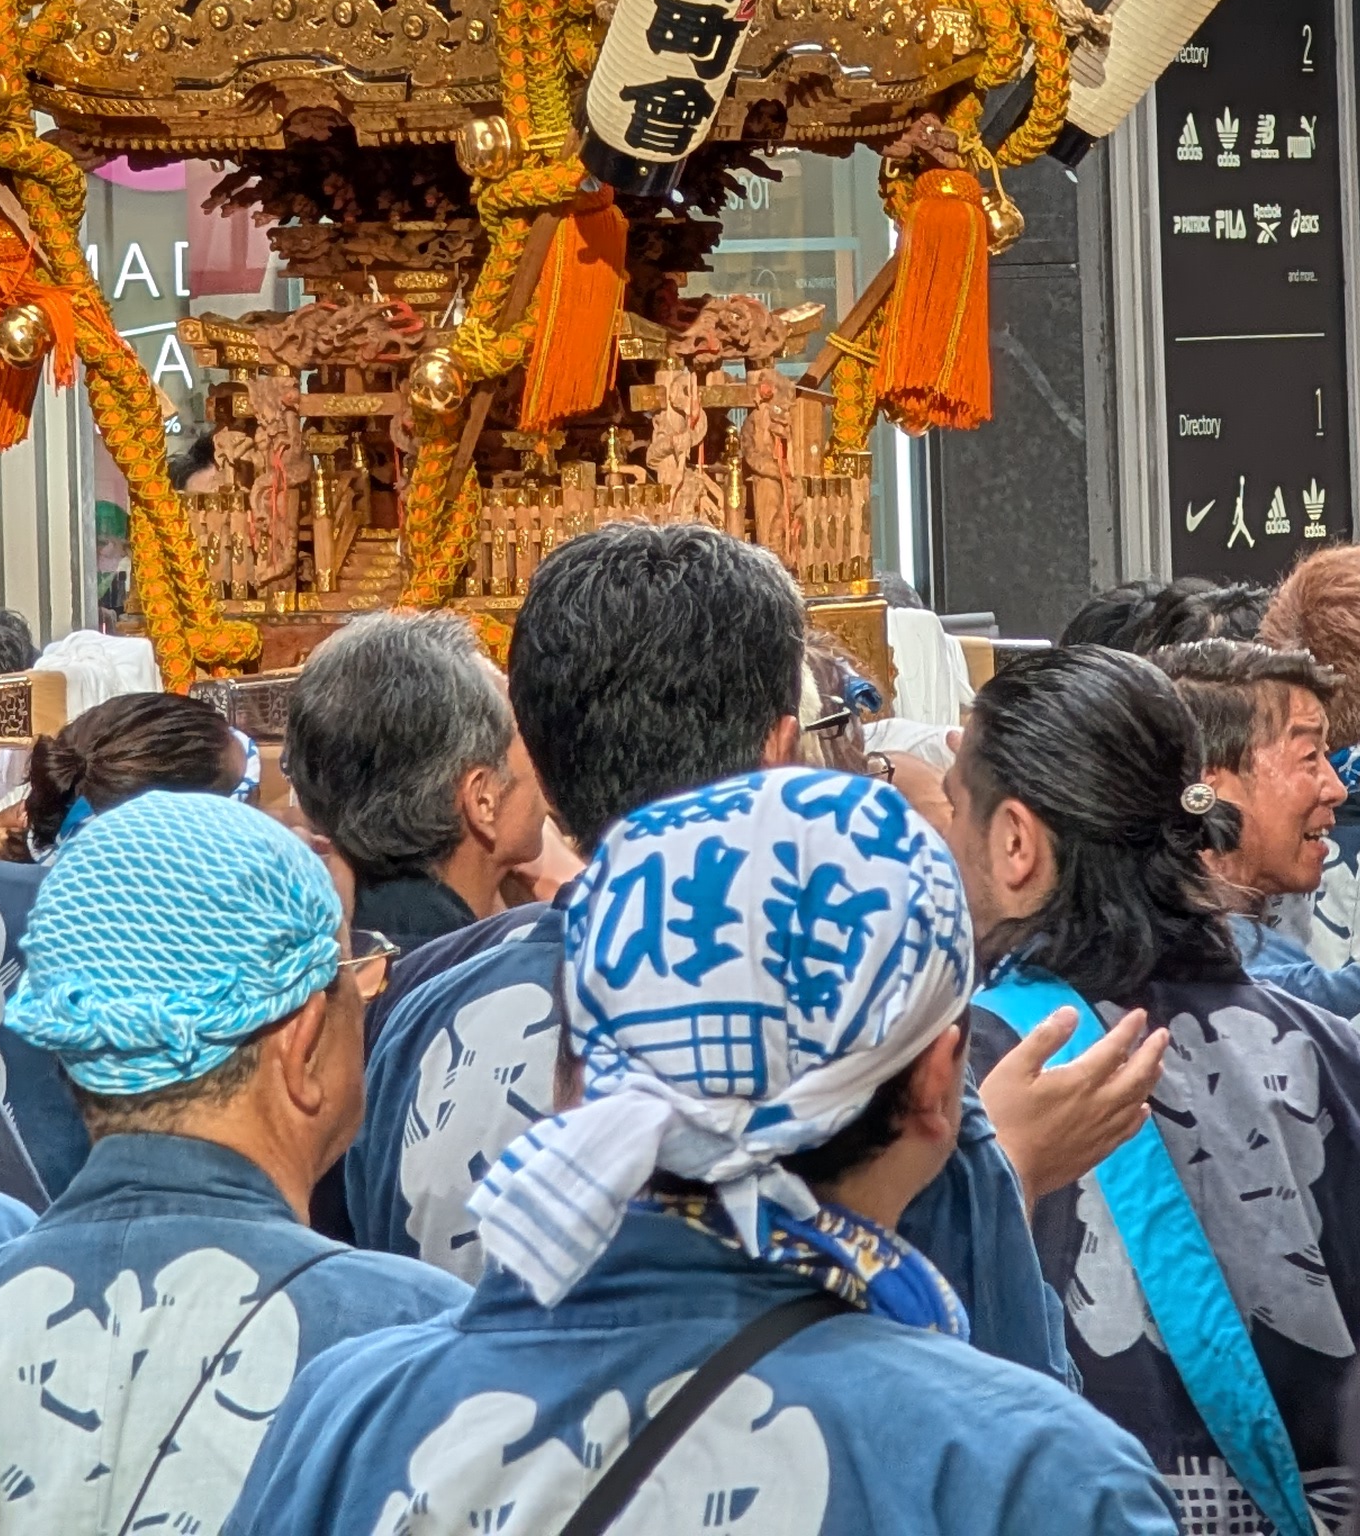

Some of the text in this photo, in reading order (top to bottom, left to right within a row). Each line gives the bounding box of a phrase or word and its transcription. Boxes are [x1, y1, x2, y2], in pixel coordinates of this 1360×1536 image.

[1171, 24, 1314, 69] rectory 2
[1215, 209, 1247, 239] FILA
[1253, 203, 1282, 220] Reebok
[1288, 270, 1299, 282] and
[1178, 387, 1323, 439] Directory 1
